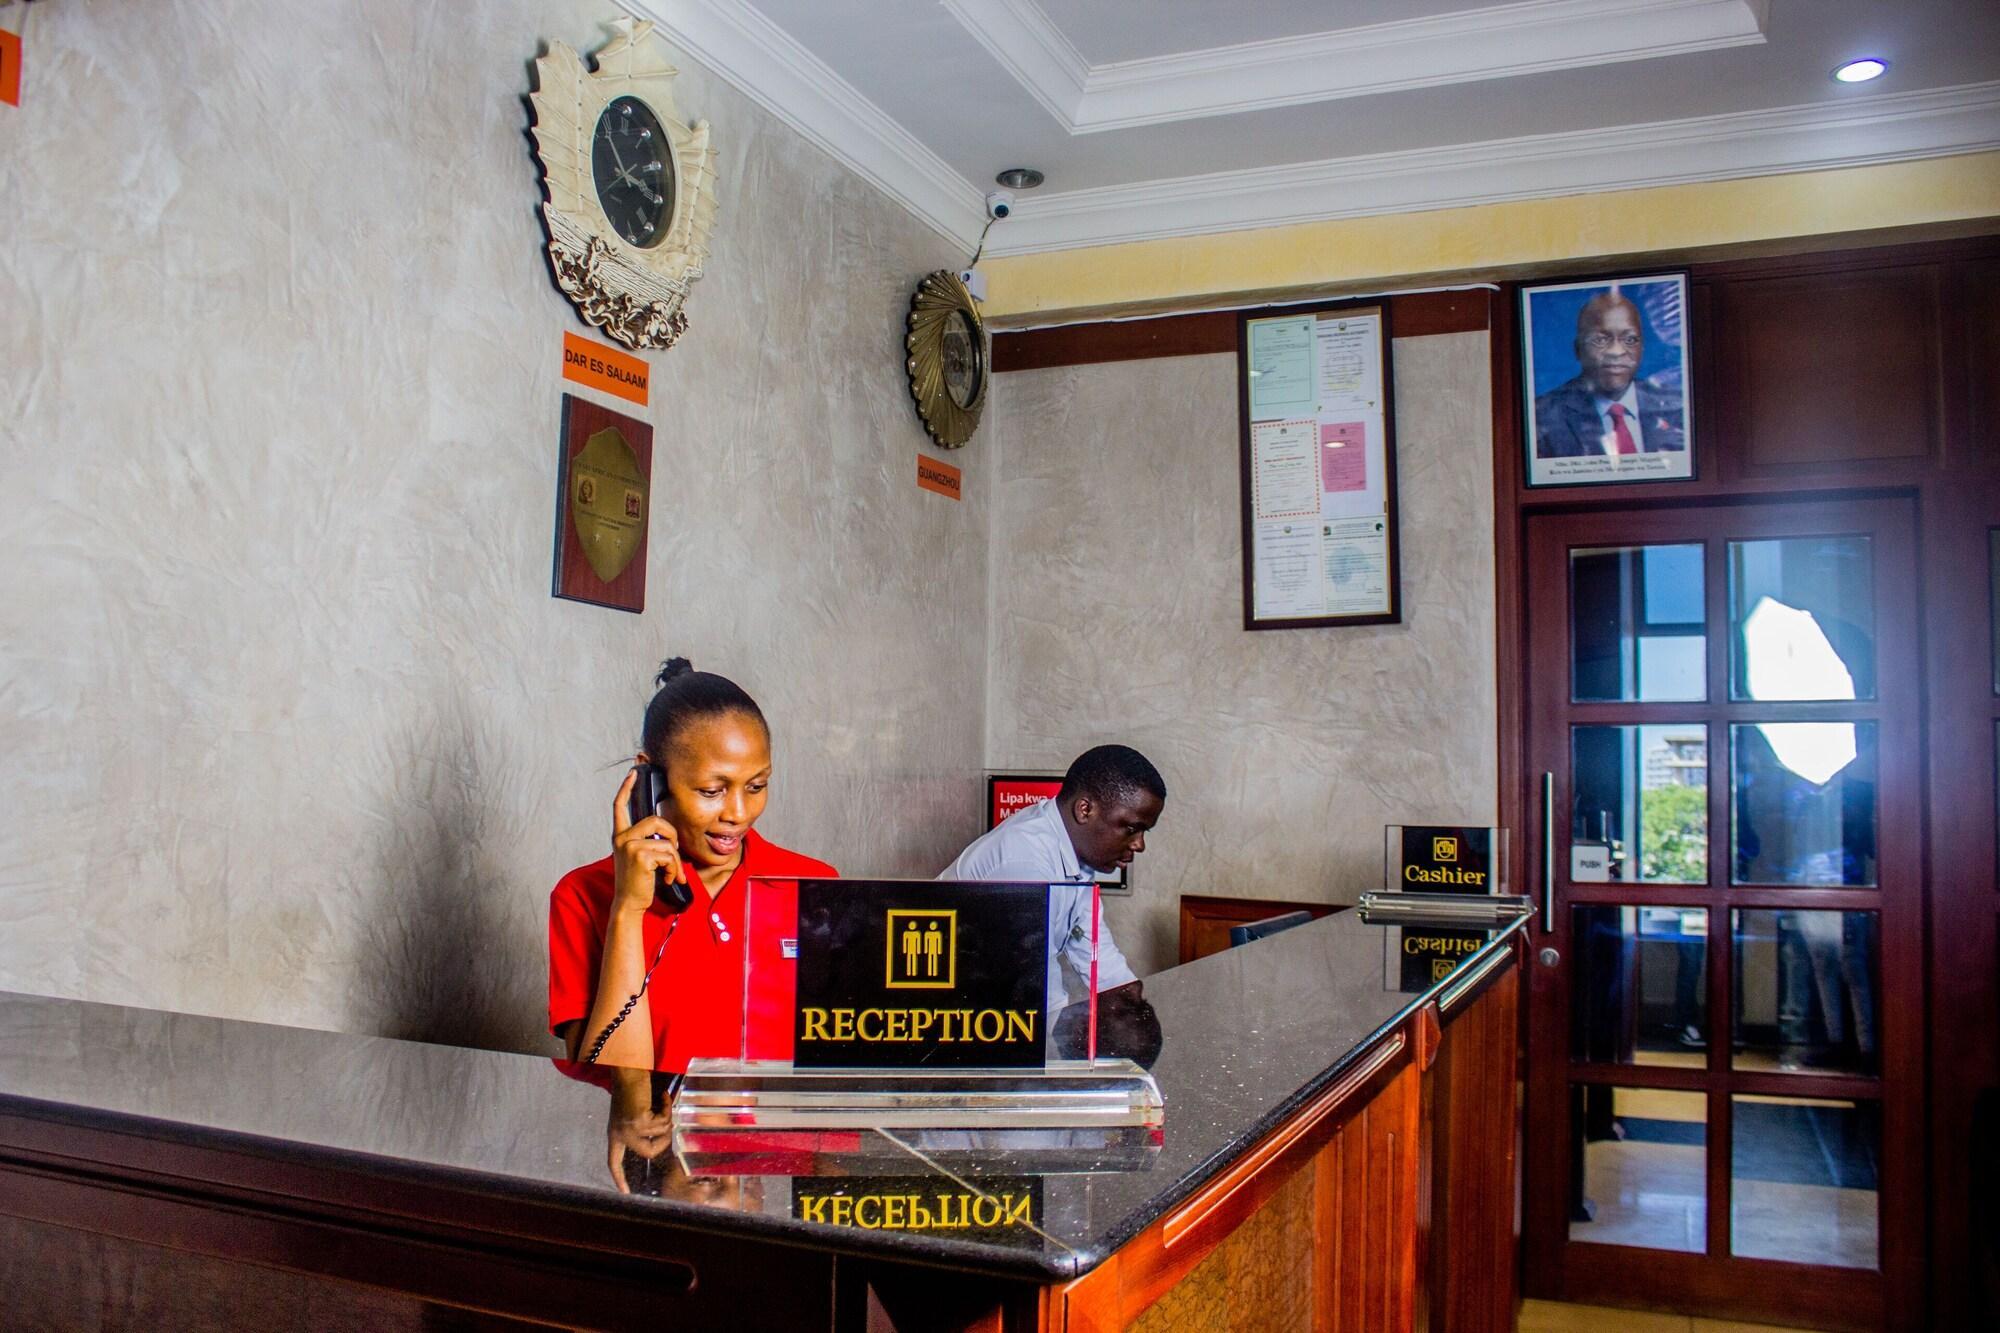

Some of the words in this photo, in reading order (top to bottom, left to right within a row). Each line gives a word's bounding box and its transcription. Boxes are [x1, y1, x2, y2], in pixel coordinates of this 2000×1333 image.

[565, 349, 587, 369] DAR
[590, 358, 604, 374] ES
[607, 363, 646, 389] SALAAM
[919, 466, 960, 491] GUANGZHOU
[1000, 792, 1024, 806] Lipa
[1405, 864, 1486, 886] Cashier
[1580, 860, 1601, 869] PUSH
[801, 1007, 1038, 1042] RECEPTION
